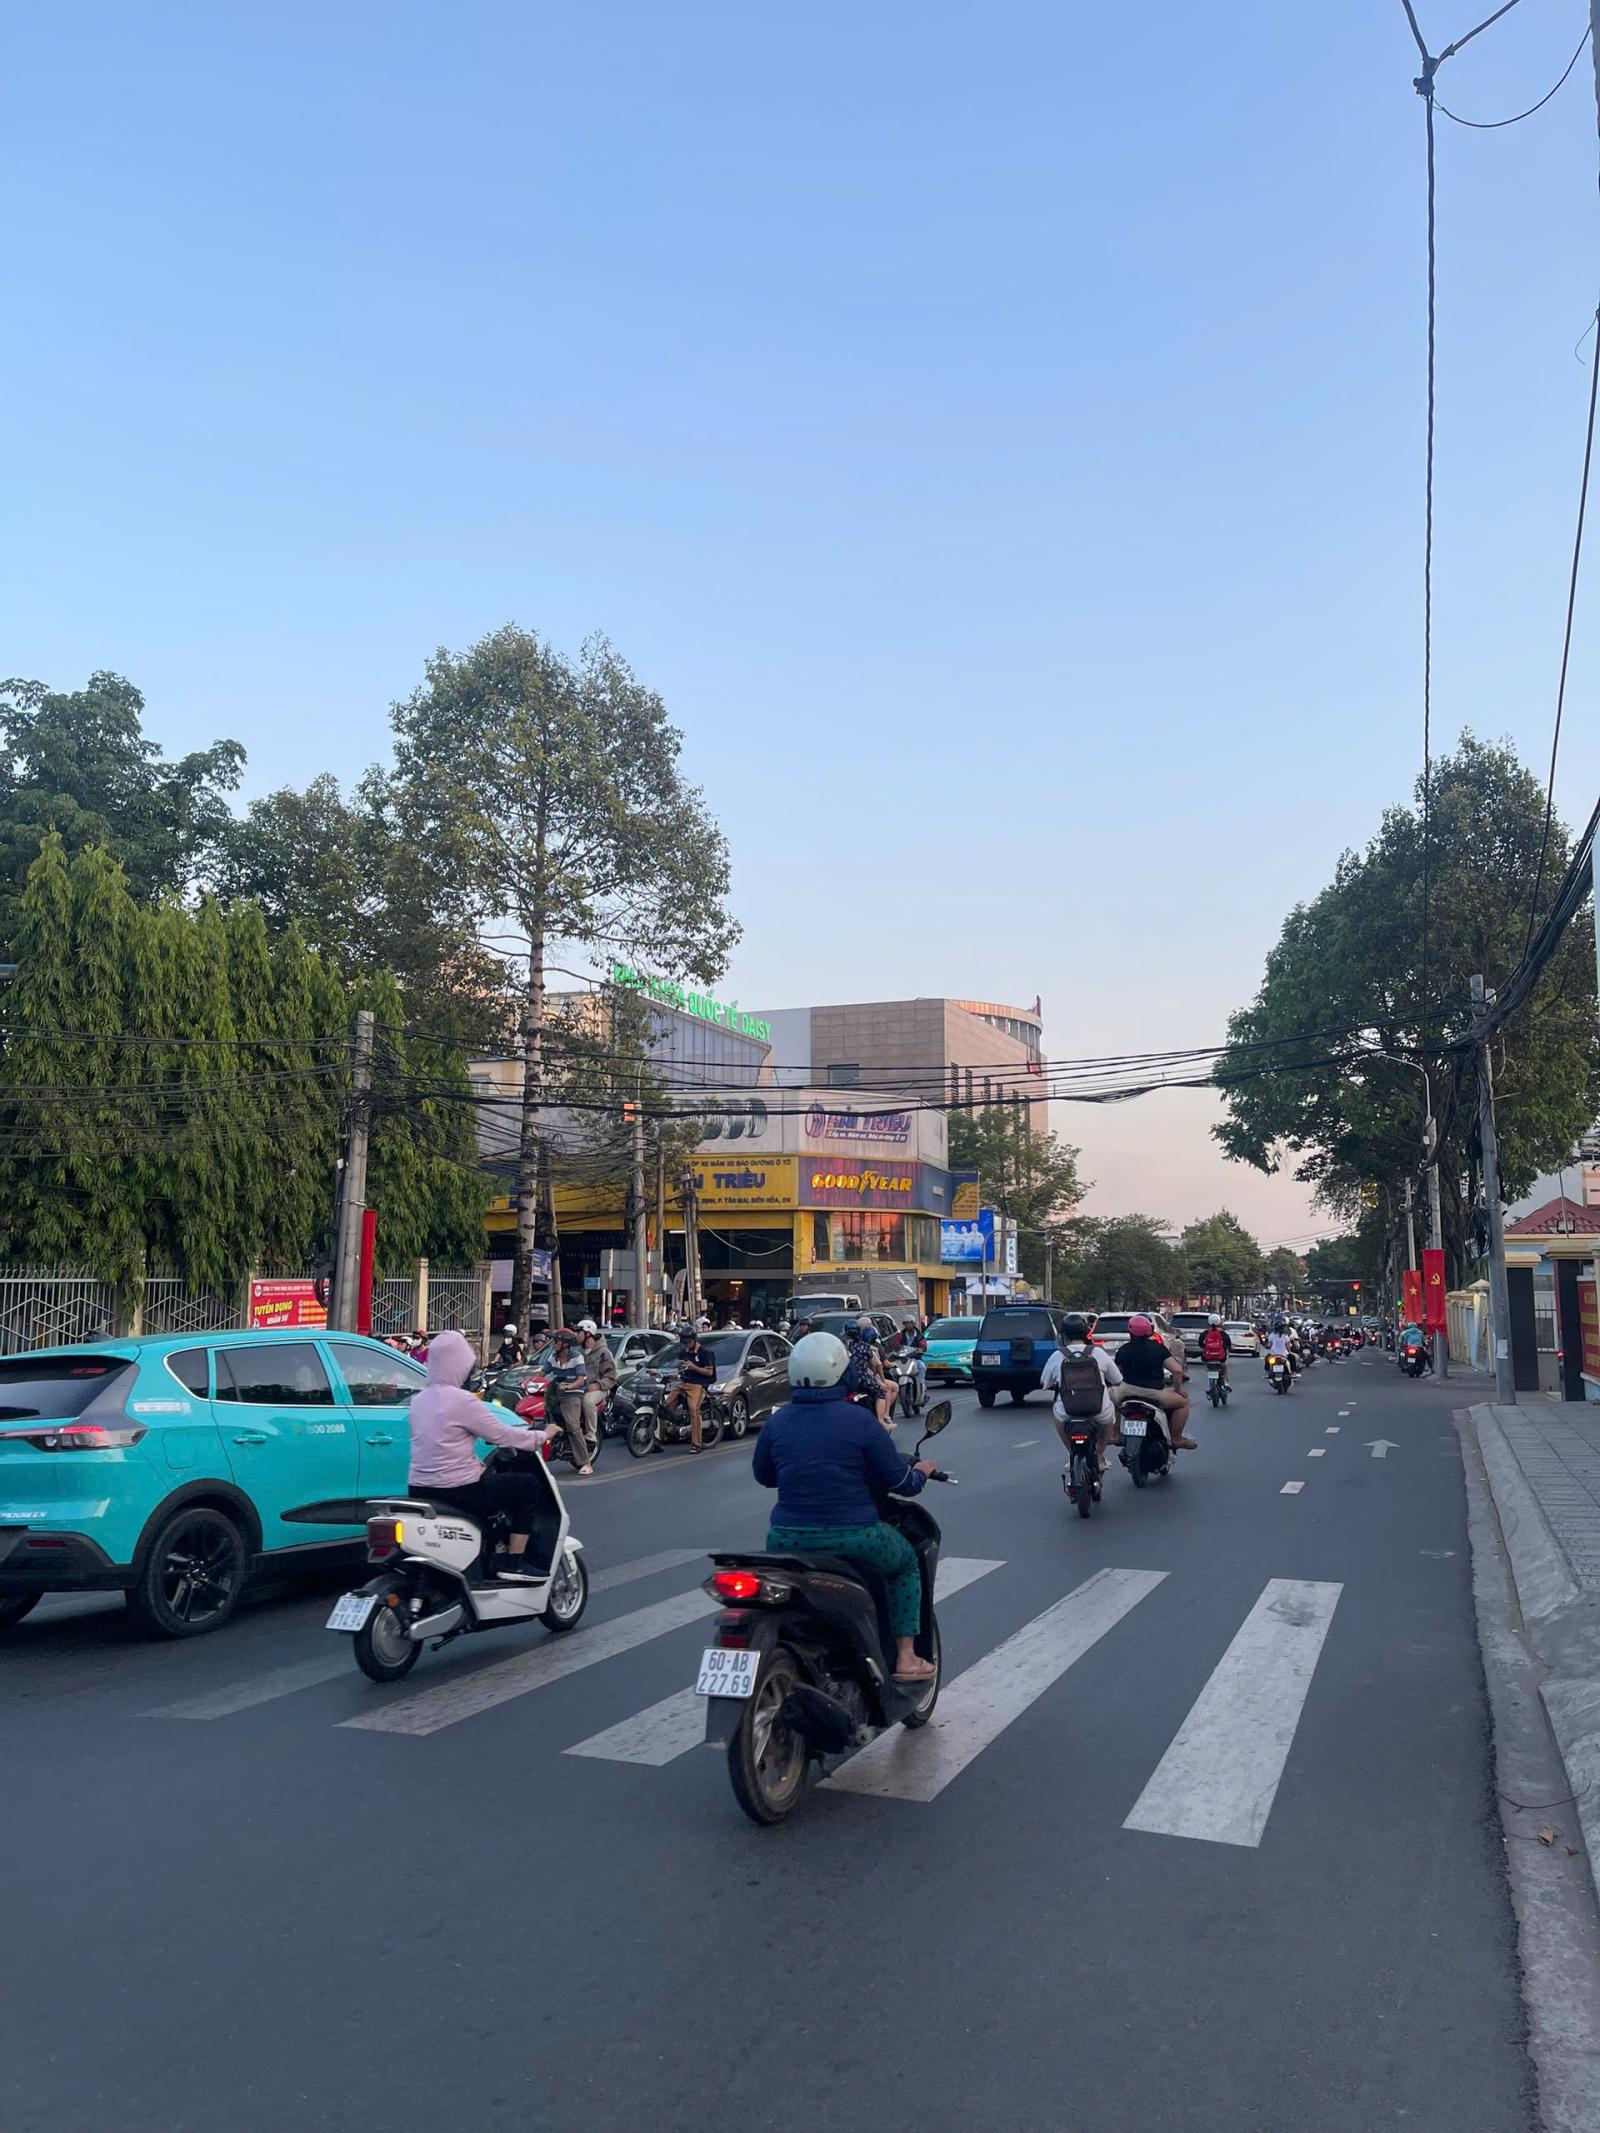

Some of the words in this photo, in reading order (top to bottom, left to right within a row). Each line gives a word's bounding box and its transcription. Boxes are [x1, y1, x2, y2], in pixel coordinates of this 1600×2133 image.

[688, 989, 722, 1024] QUỐC
[723, 1001, 739, 1031] TẾ
[741, 1013, 773, 1042] DAISY
[811, 1171, 912, 1193] GOODYEAR
[708, 1651, 749, 1672] 60-AB
[698, 1672, 750, 1694] 227.69
